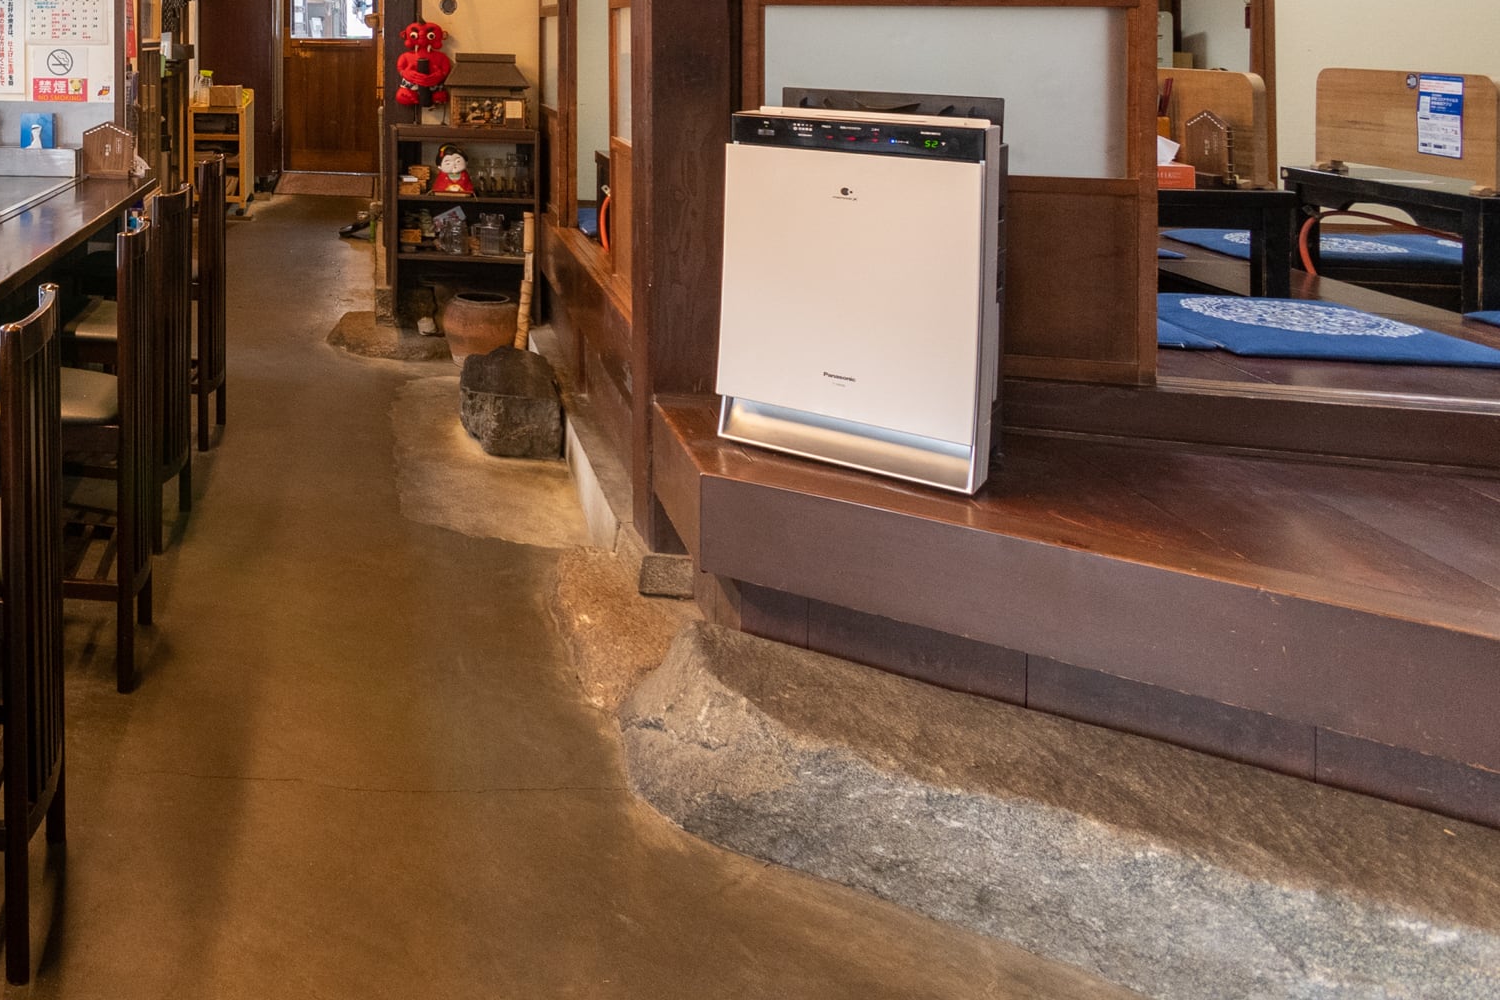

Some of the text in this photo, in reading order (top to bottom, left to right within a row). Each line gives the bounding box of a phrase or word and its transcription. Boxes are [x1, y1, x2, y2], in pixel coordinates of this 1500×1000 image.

[38, 80, 67, 94] 禁煙
[924, 140, 938, 148] 52
[823, 371, 856, 382] Panasonic
